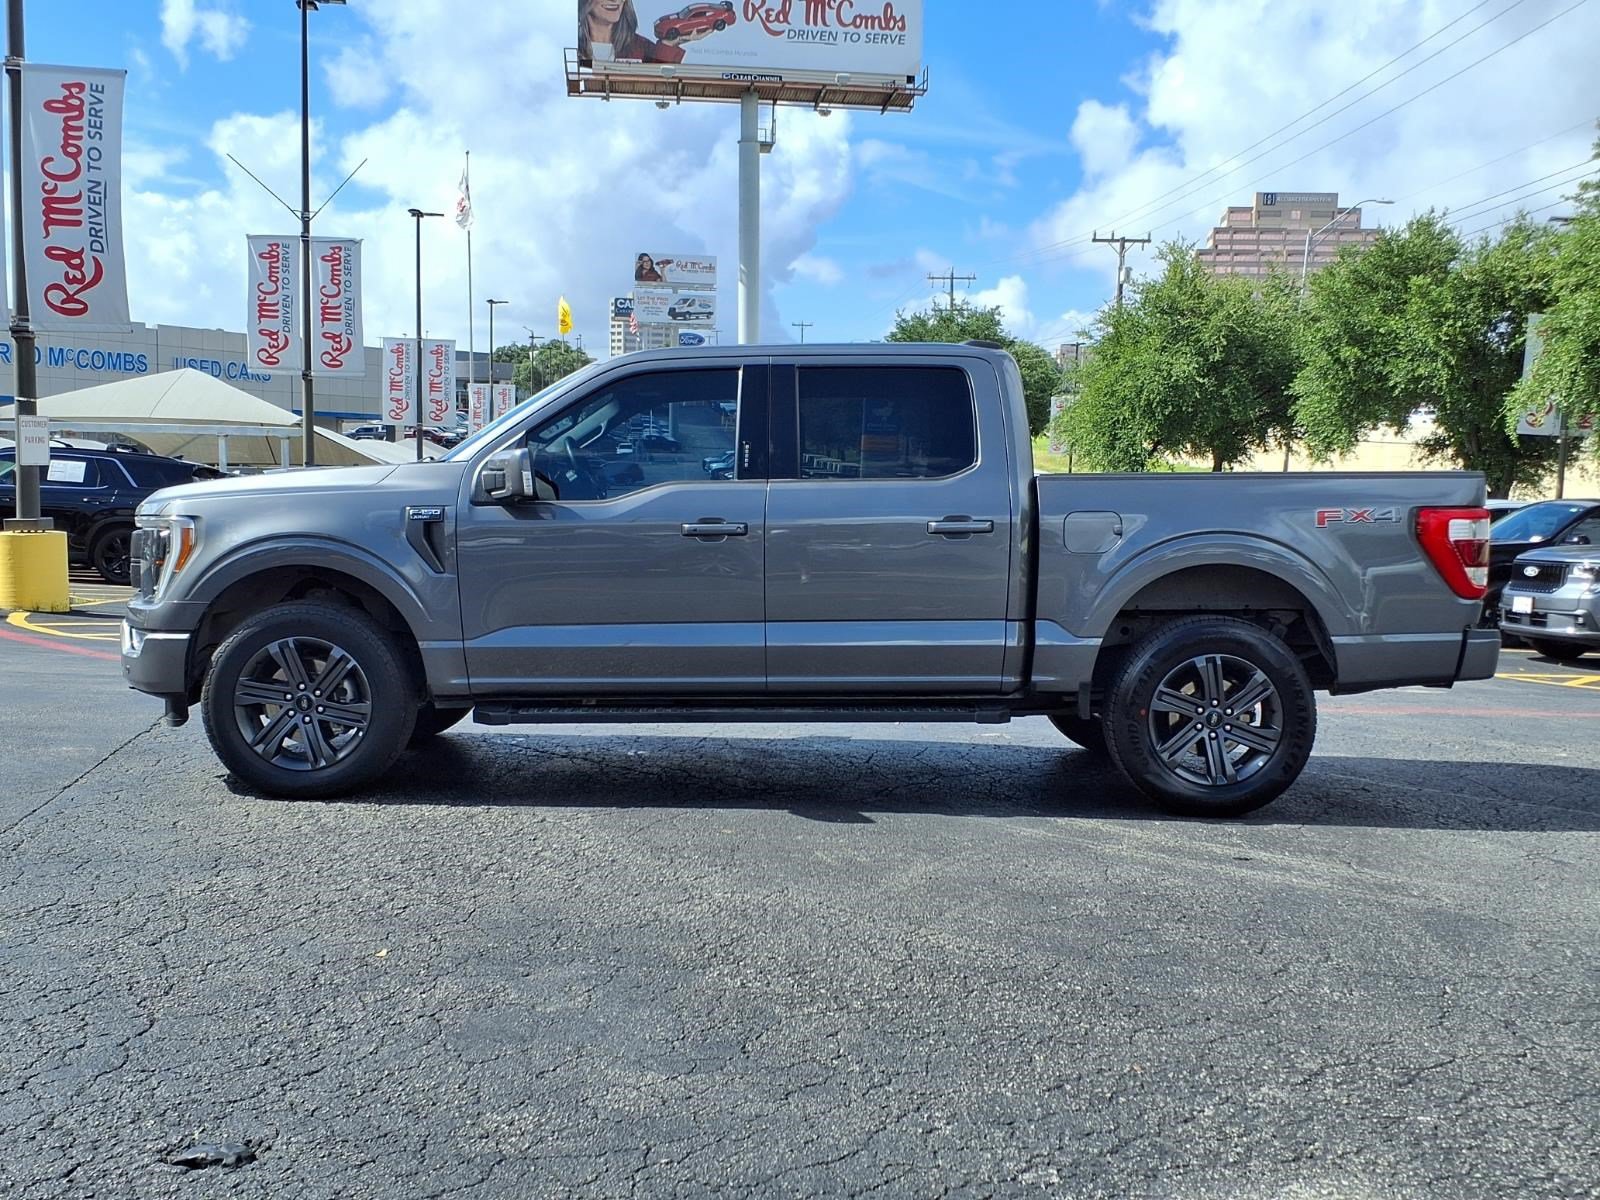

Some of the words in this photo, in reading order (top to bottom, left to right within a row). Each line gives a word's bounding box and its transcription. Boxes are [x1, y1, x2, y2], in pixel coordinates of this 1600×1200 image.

[743, 0, 792, 37] Red
[805, 0, 906, 32] McCombs
[787, 29, 838, 42] DRIVEN
[843, 32, 861, 43] TO
[865, 33, 906, 45] SERVE
[88, 82, 105, 141] SERVE
[41, 82, 86, 239] McCombs
[87, 147, 102, 172] TO
[88, 180, 105, 254] DRIVEN
[281, 242, 290, 274] SERVE
[344, 247, 352, 278] SERVE
[44, 246, 104, 317] Red
[257, 242, 280, 325] McCombs
[281, 277, 290, 290] TO
[320, 245, 343, 328] McCombs
[344, 280, 352, 293] TO
[282, 294, 291, 333] DRIVEN
[344, 298, 353, 336] DRIVEN
[0, 343, 41, 365] RD
[257, 328, 289, 365] Red
[320, 332, 352, 368] Red
[680, 335, 699, 344] Ford
[21, 420, 47, 428] CUSTOMER
[388, 397, 409, 420] Red
[429, 398, 448, 421] Red
[24, 436, 45, 444] PARKING
[1314, 507, 1402, 528] FX4
